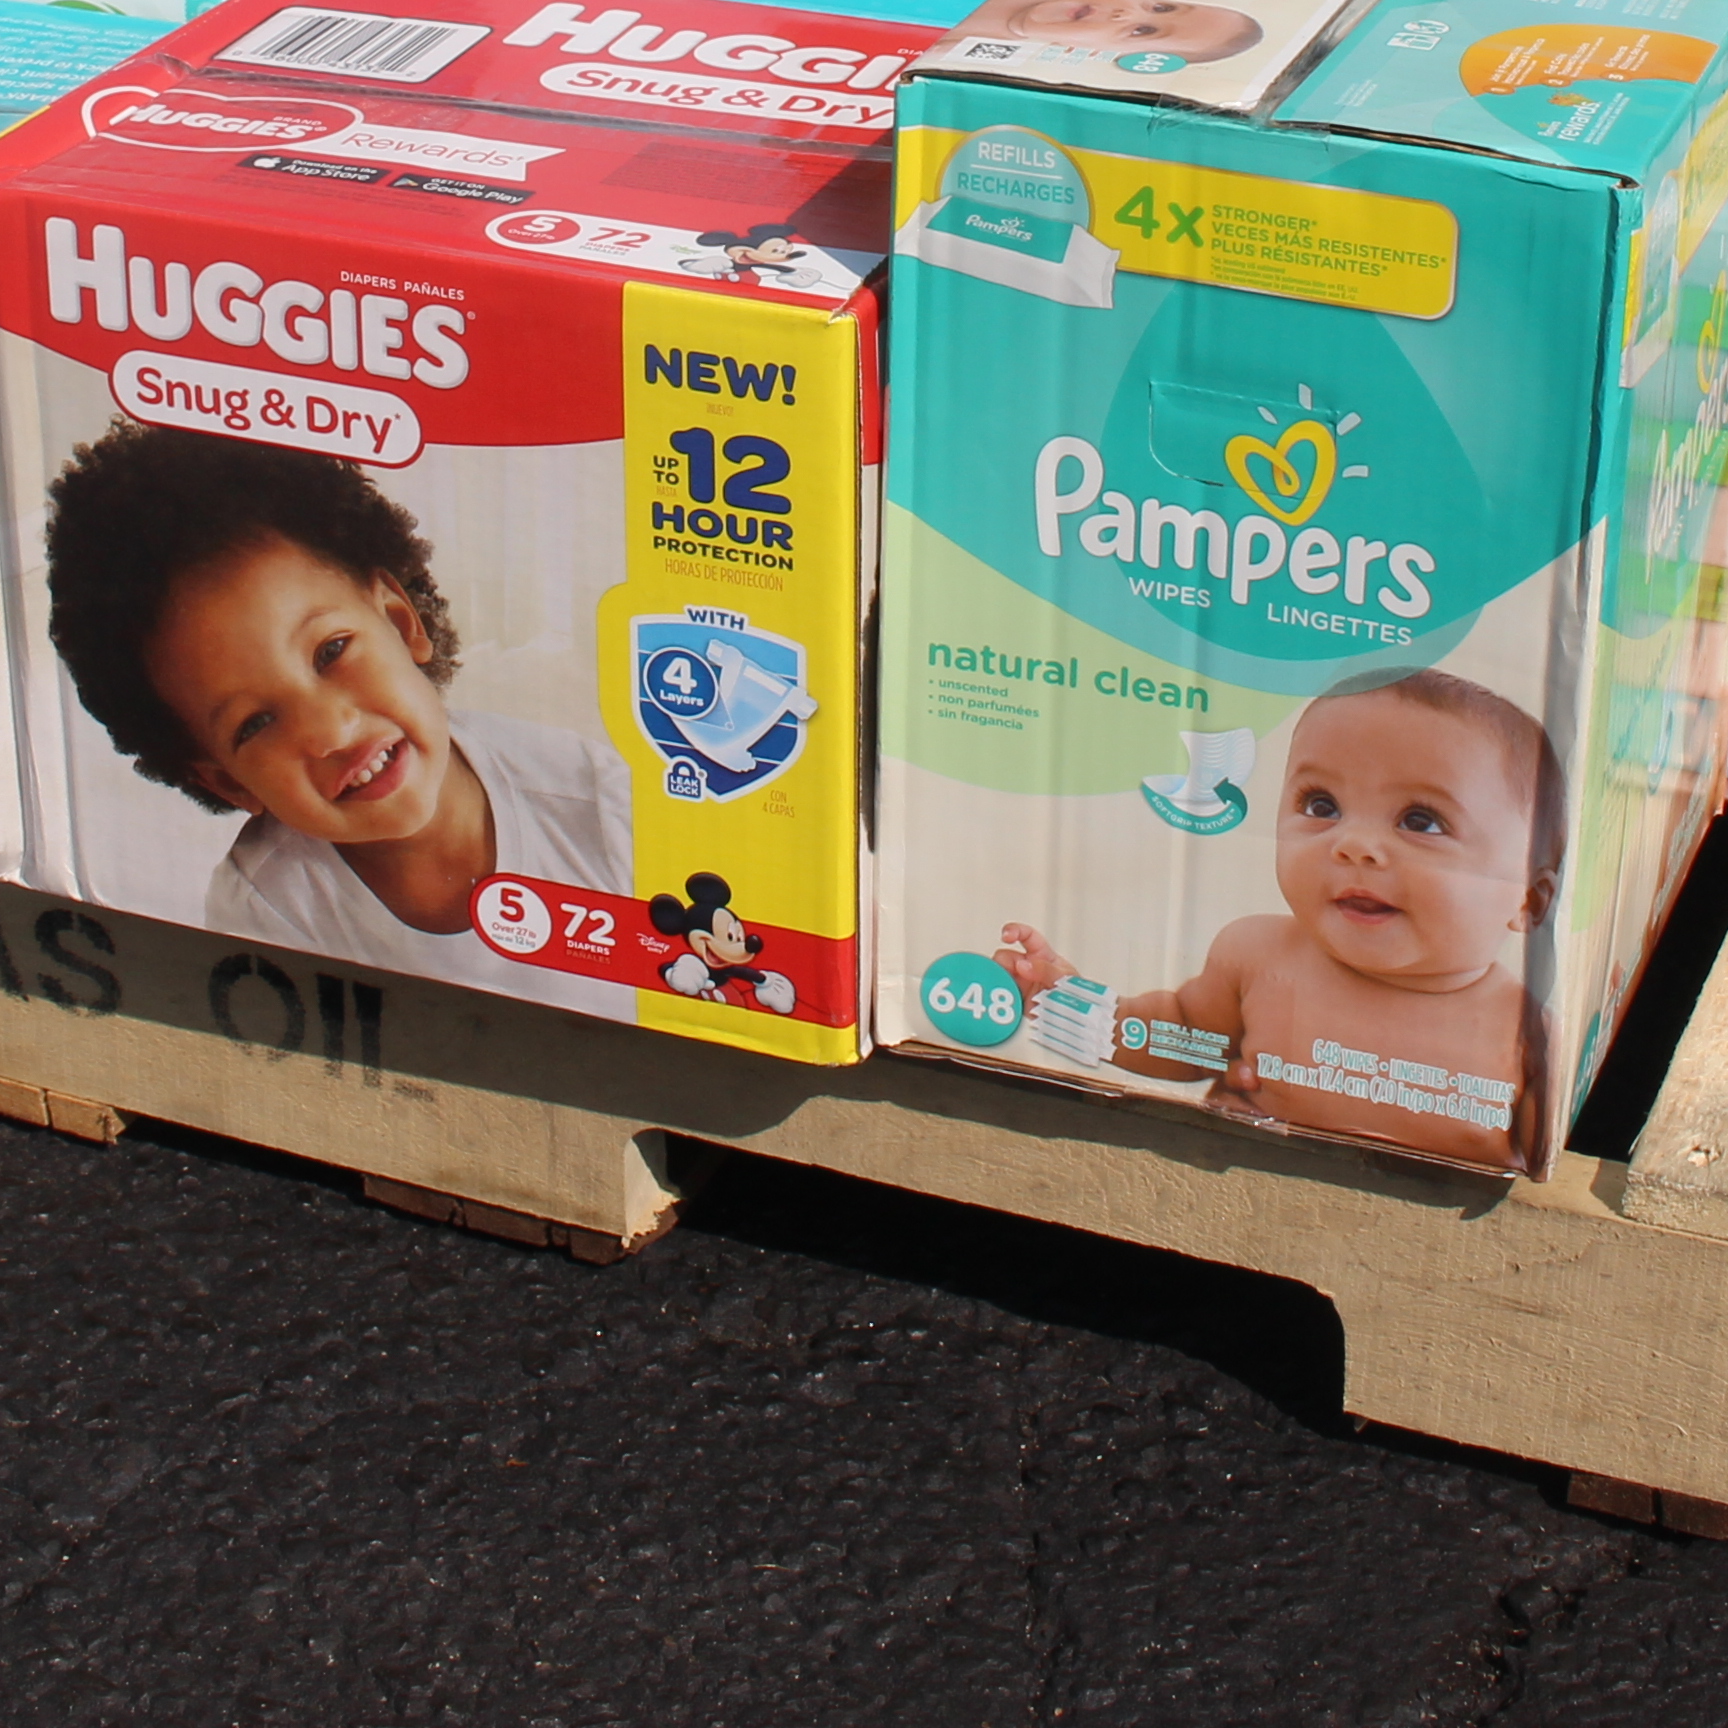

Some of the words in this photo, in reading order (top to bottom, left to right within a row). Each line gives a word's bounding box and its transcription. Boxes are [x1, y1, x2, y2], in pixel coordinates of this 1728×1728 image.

[110, 104, 318, 140] HUGGIES
[341, 133, 514, 167] Rewards
[977, 141, 1056, 168] REFILLS
[956, 172, 1076, 205] RECHARGES
[588, 227, 652, 248] 72
[1211, 221, 1269, 244] VECES
[1274, 227, 1313, 250] MÁS
[1211, 238, 1267, 261] PLUS
[45, 216, 470, 389] HUGGIES
[340, 270, 398, 291] DIAPERS
[403, 277, 466, 302] PAÑALES
[644, 343, 798, 406] NEW!
[136, 366, 251, 431] Snug
[260, 389, 296, 428] &
[305, 395, 392, 454] Dry
[652, 470, 680, 486] TO
[653, 455, 680, 470] UP
[669, 427, 793, 516] 12
[651, 501, 795, 552] HOUR
[1034, 436, 1436, 620] Pampers
[653, 535, 795, 572] PROTECTION
[686, 607, 746, 631] WITH
[1128, 575, 1212, 610] WIPES
[1266, 601, 1413, 648] LINGETTES
[662, 656, 698, 695] 4
[927, 635, 1079, 689] natural
[1093, 666, 1210, 714] clean
[938, 678, 1009, 699] unscented
[659, 689, 705, 708] Layers
[938, 693, 964, 706] non
[967, 697, 1041, 720] parfumées
[937, 708, 957, 721] sin
[960, 710, 1024, 732] fragancia
[499, 887, 525, 923] 5
[560, 902, 616, 946] 72
[567, 939, 611, 956] DIAPERS
[927, 975, 1016, 1025] 648
[208, 950, 437, 1103] OIL
[1120, 1017, 1147, 1052] 9
